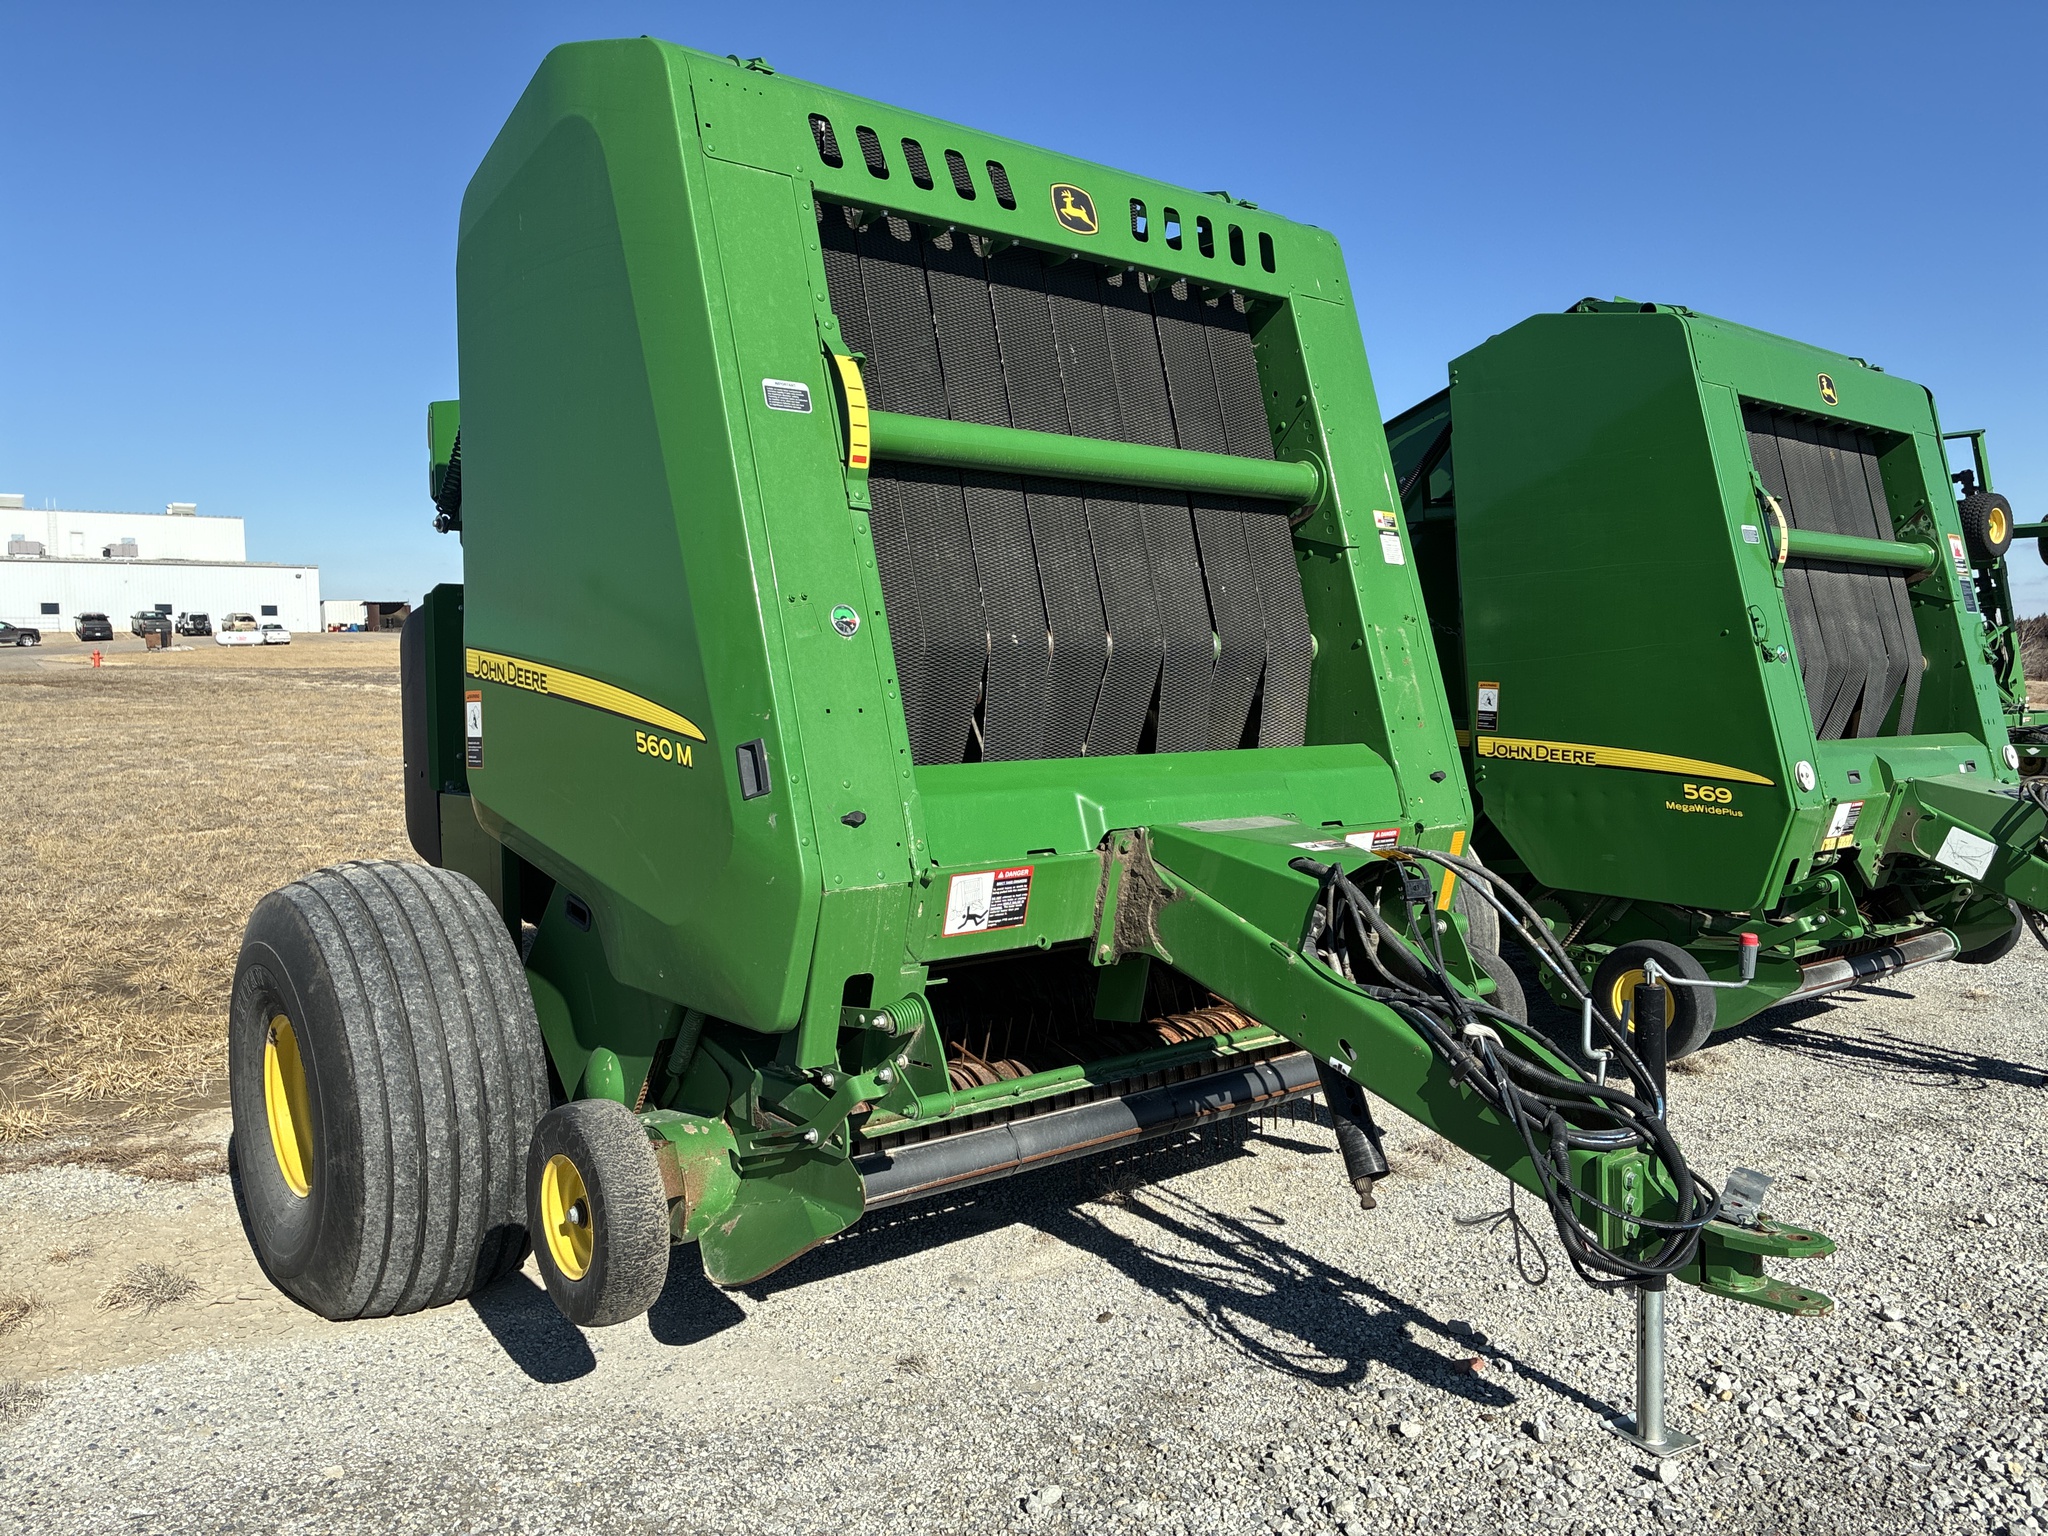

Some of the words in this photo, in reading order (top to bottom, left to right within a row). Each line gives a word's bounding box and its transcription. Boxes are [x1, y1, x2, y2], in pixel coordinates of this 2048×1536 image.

[474, 655, 506, 682] JOHN
[507, 661, 548, 691] DEERE
[635, 729, 673, 761] 560
[676, 741, 693, 769] M
[1487, 741, 1533, 760] JOHN
[1535, 744, 1596, 764] DEERE
[1683, 783, 1733, 804] 569
[1665, 800, 1744, 818] MegaWidePlus
[1004, 868, 1029, 878] DANGER
